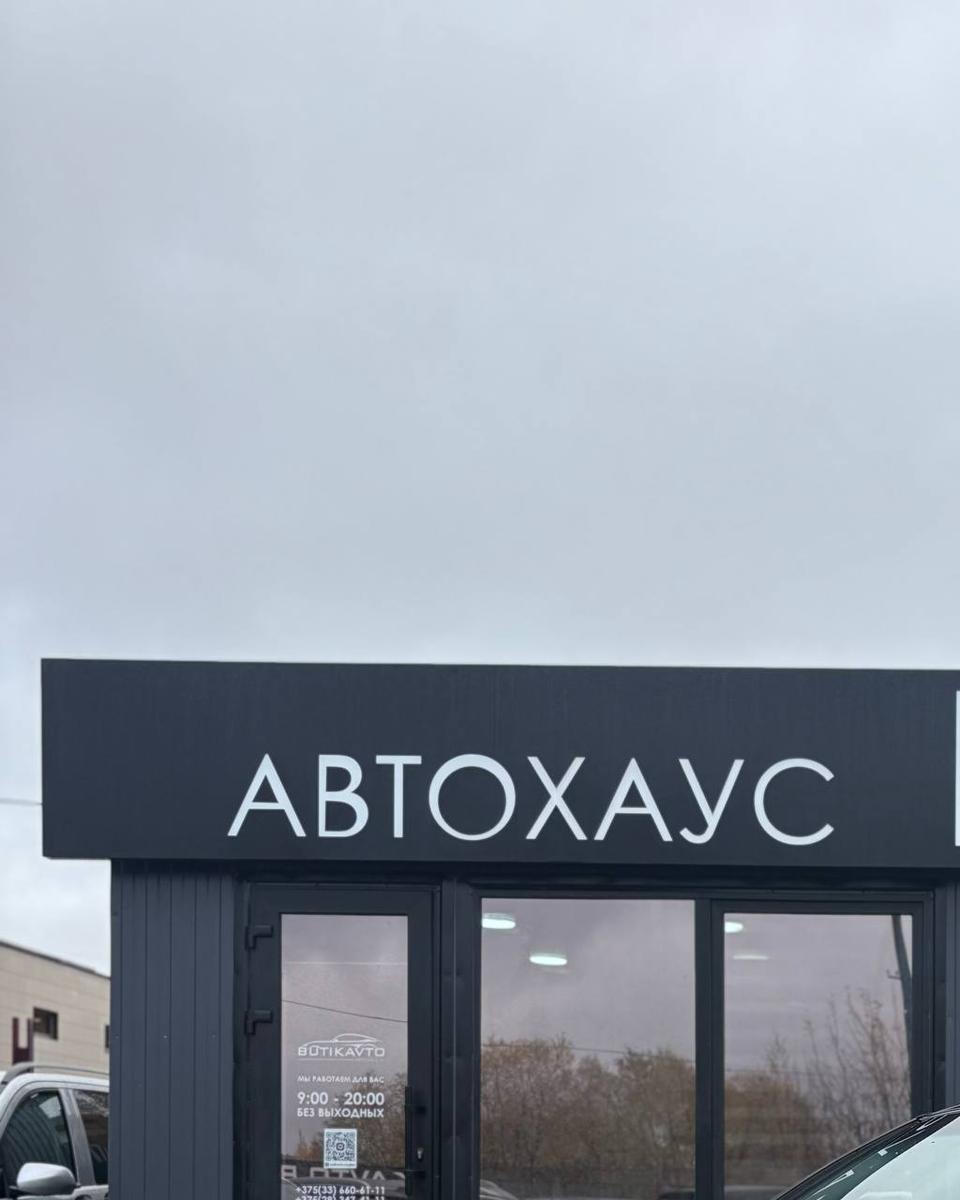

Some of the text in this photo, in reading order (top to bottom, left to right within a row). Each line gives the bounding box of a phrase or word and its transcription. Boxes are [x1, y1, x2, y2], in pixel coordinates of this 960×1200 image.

[228, 754, 835, 846] АВТОХАУС
[298, 1045, 385, 1057] BUTIKAVTO
[312, 1075, 351, 1083] РАБОТАЕМ
[297, 1091, 328, 1105] 9:00
[344, 1092, 385, 1105] 20:00
[297, 1107, 384, 1119] БЕЗ ВЫХОДНЫХ
